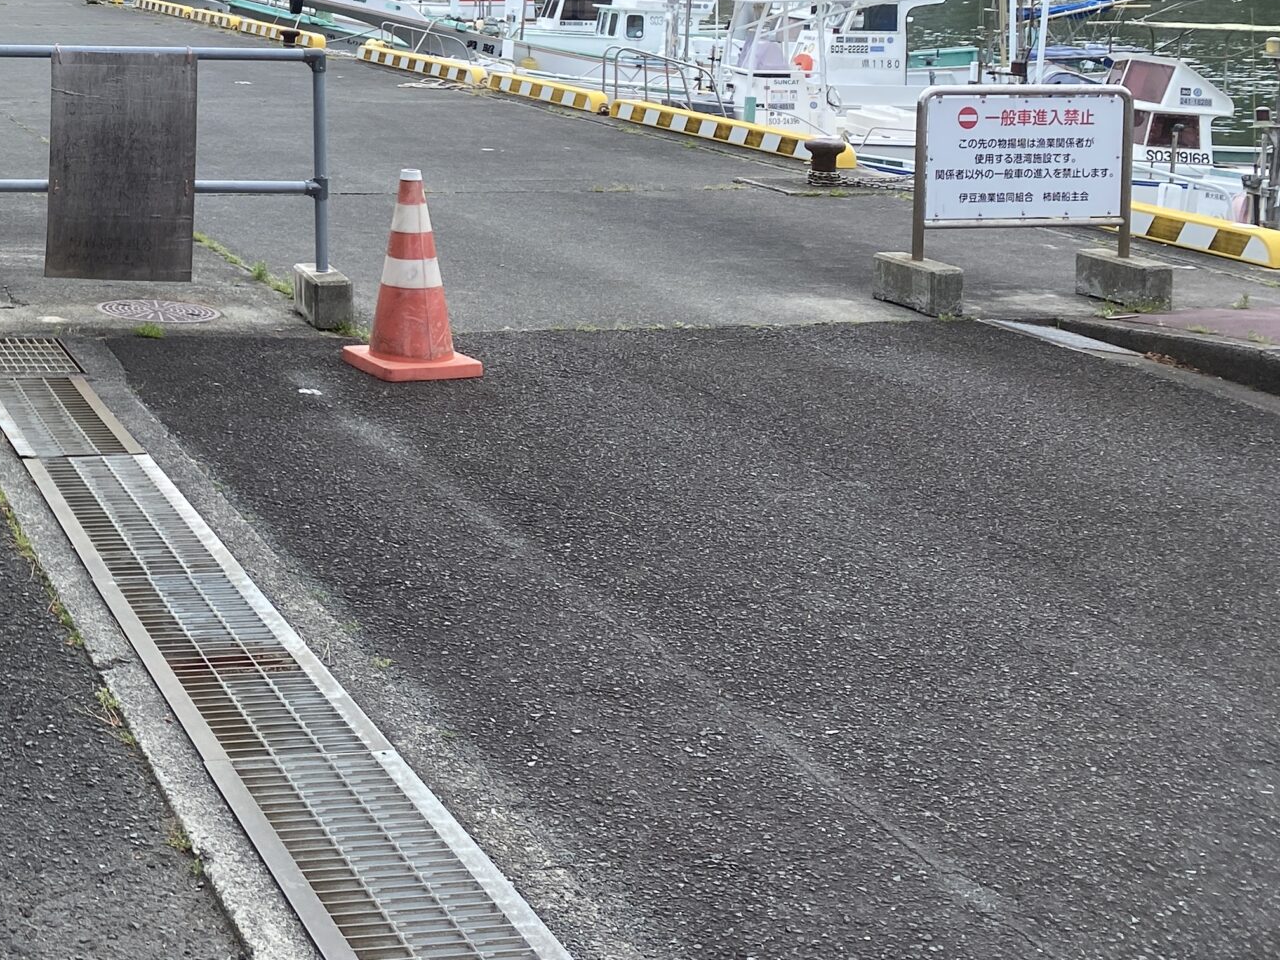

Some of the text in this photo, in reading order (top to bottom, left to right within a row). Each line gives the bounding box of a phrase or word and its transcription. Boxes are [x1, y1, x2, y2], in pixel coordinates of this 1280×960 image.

[985, 109, 1095, 127] 一般車進入禁止
[958, 137, 1095, 149] この先の物揚場は漁業関係者が
[974, 153, 1076, 164] 使用する港湾施設です。
[935, 168, 1114, 180] 関係者以外の一般車の進入を禁止します。
[959, 191, 1034, 203] 伊豆漁業協同組合
